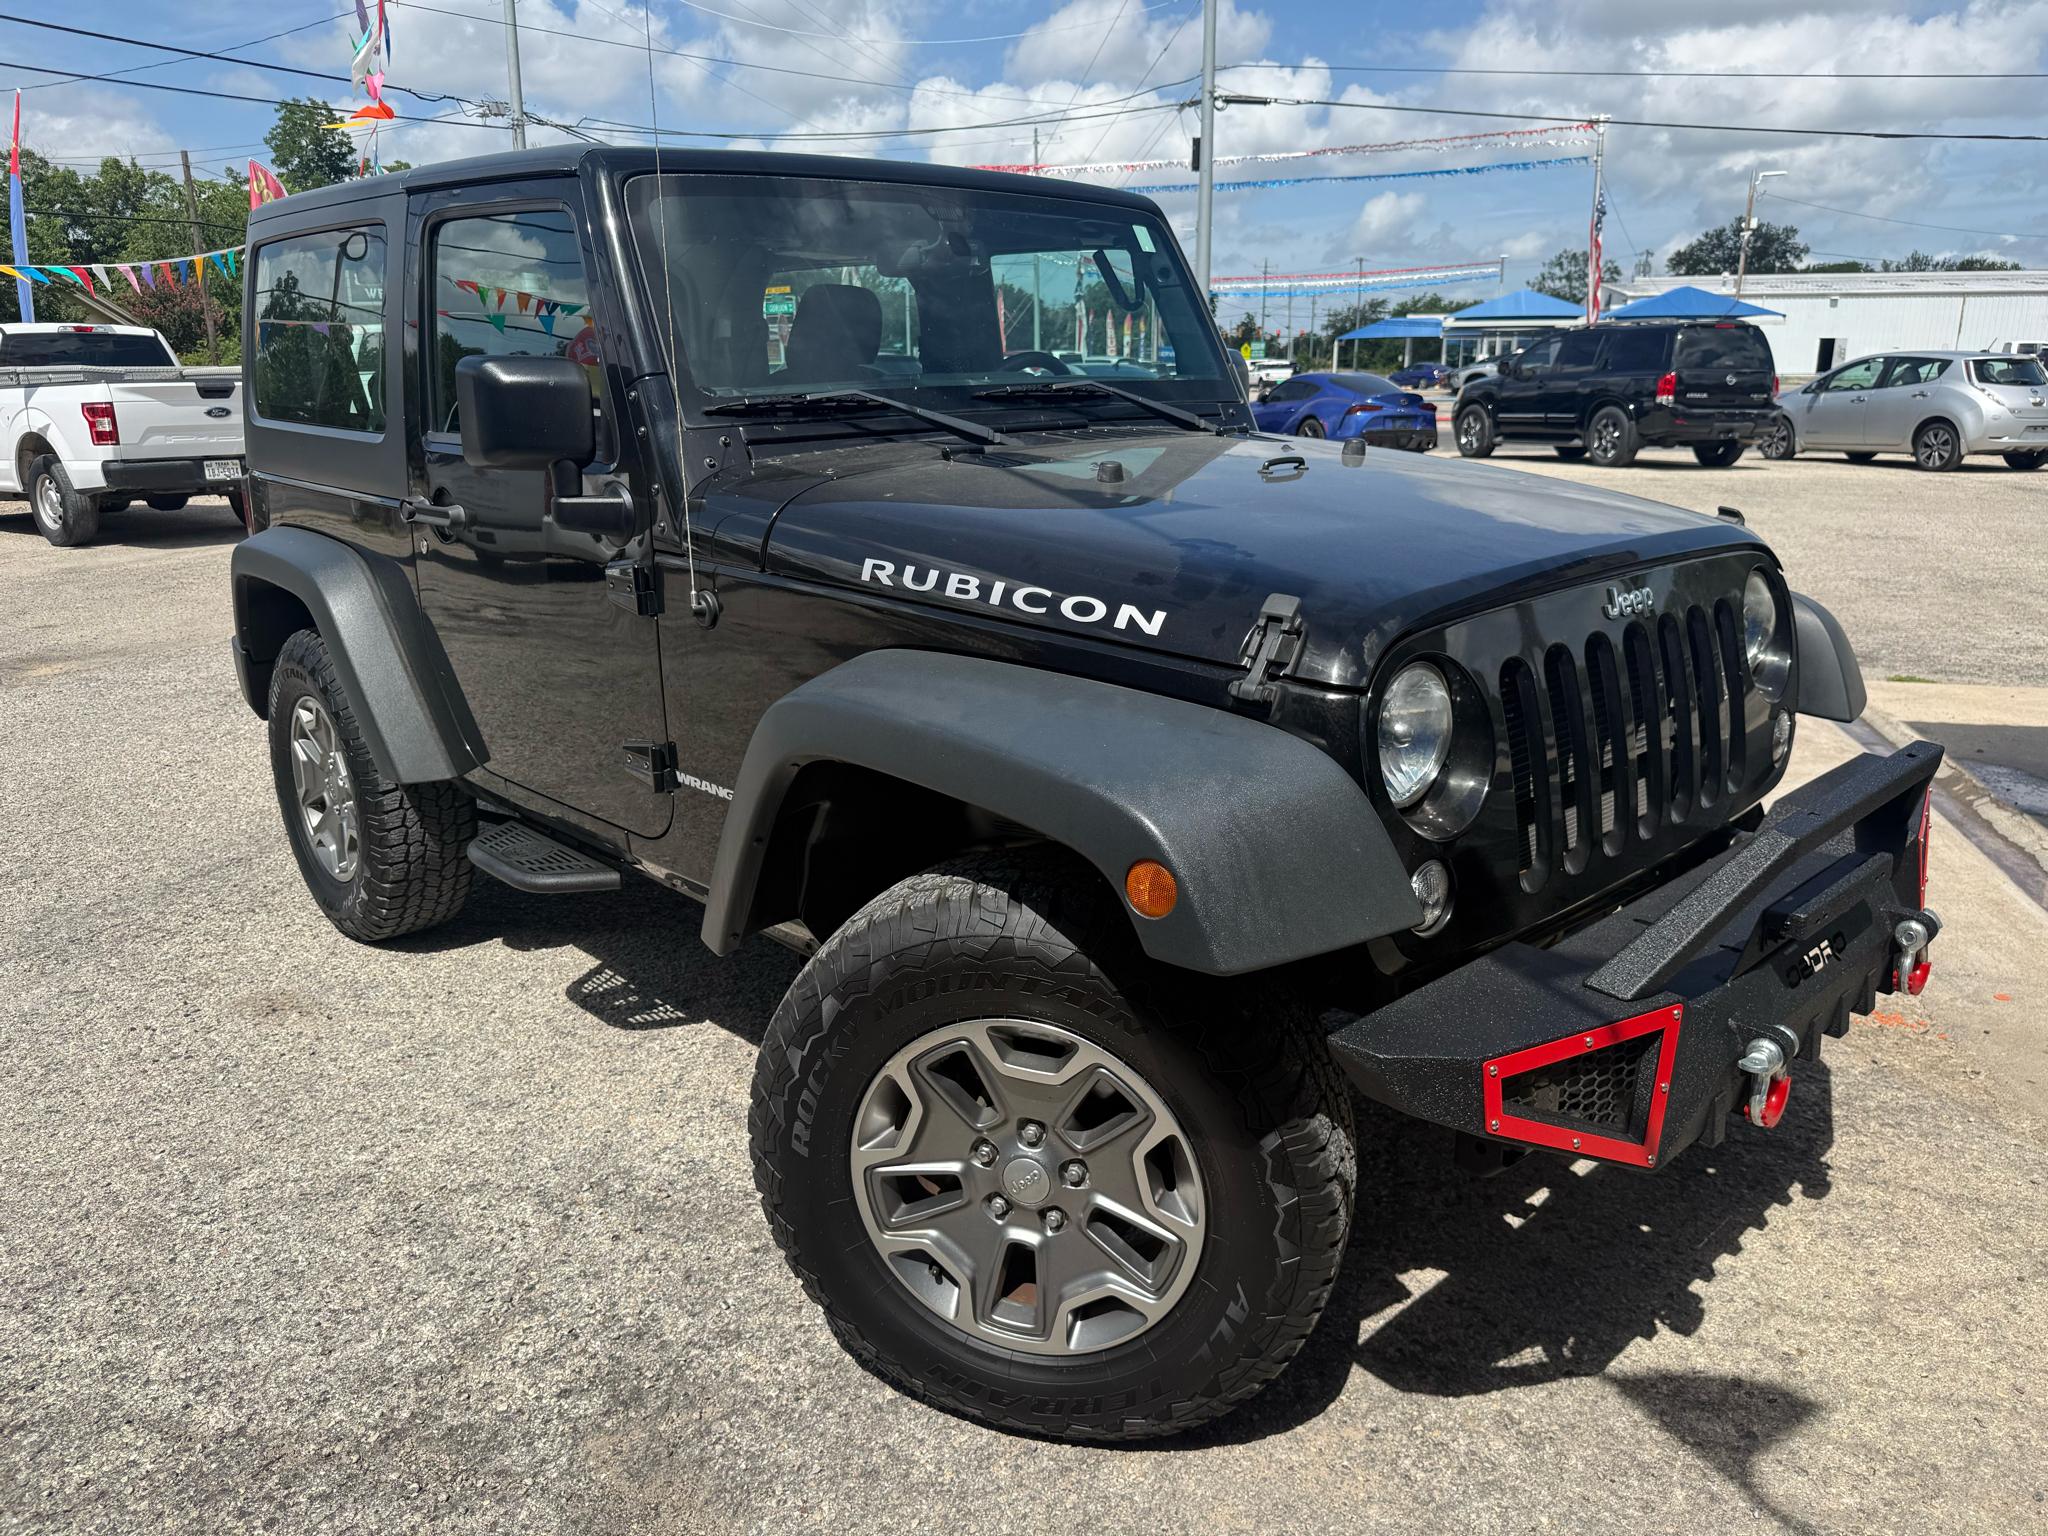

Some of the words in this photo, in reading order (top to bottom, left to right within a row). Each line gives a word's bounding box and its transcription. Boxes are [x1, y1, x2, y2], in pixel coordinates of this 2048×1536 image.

[861, 558, 1167, 636] RUBICON
[1602, 586, 1654, 619] Jeep
[876, 970, 1150, 1040] MOUNTAIN
[1011, 1169, 1041, 1194] Jeep
[1188, 1280, 1250, 1367] ALL
